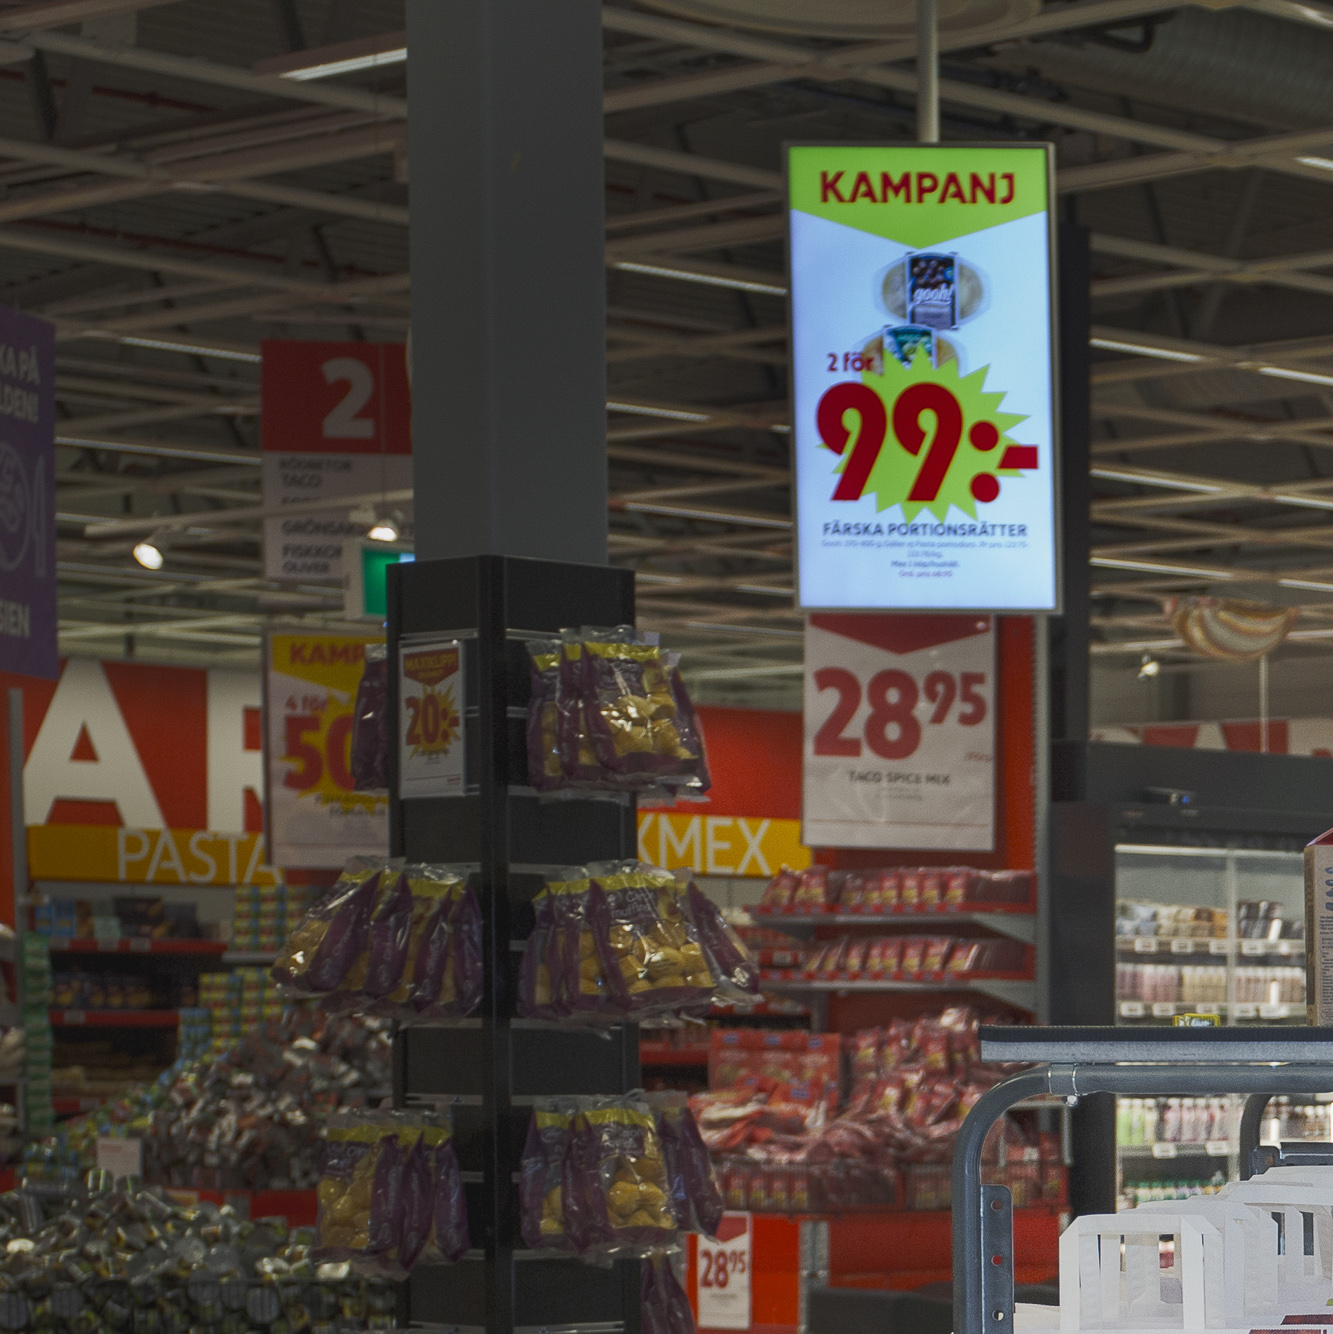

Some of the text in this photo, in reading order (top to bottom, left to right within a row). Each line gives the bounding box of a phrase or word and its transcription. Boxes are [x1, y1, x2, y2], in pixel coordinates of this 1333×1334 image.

[820, 169, 1016, 205] KAMPANJ
[827, 350, 875, 372] 2 för
[321, 357, 375, 439] 2
[816, 381, 1039, 503] 99:-
[822, 519, 1029, 538] FÄRSKA PORTIONSRÄTTER
[849, 771, 951, 786] TACO SPICE MIX
